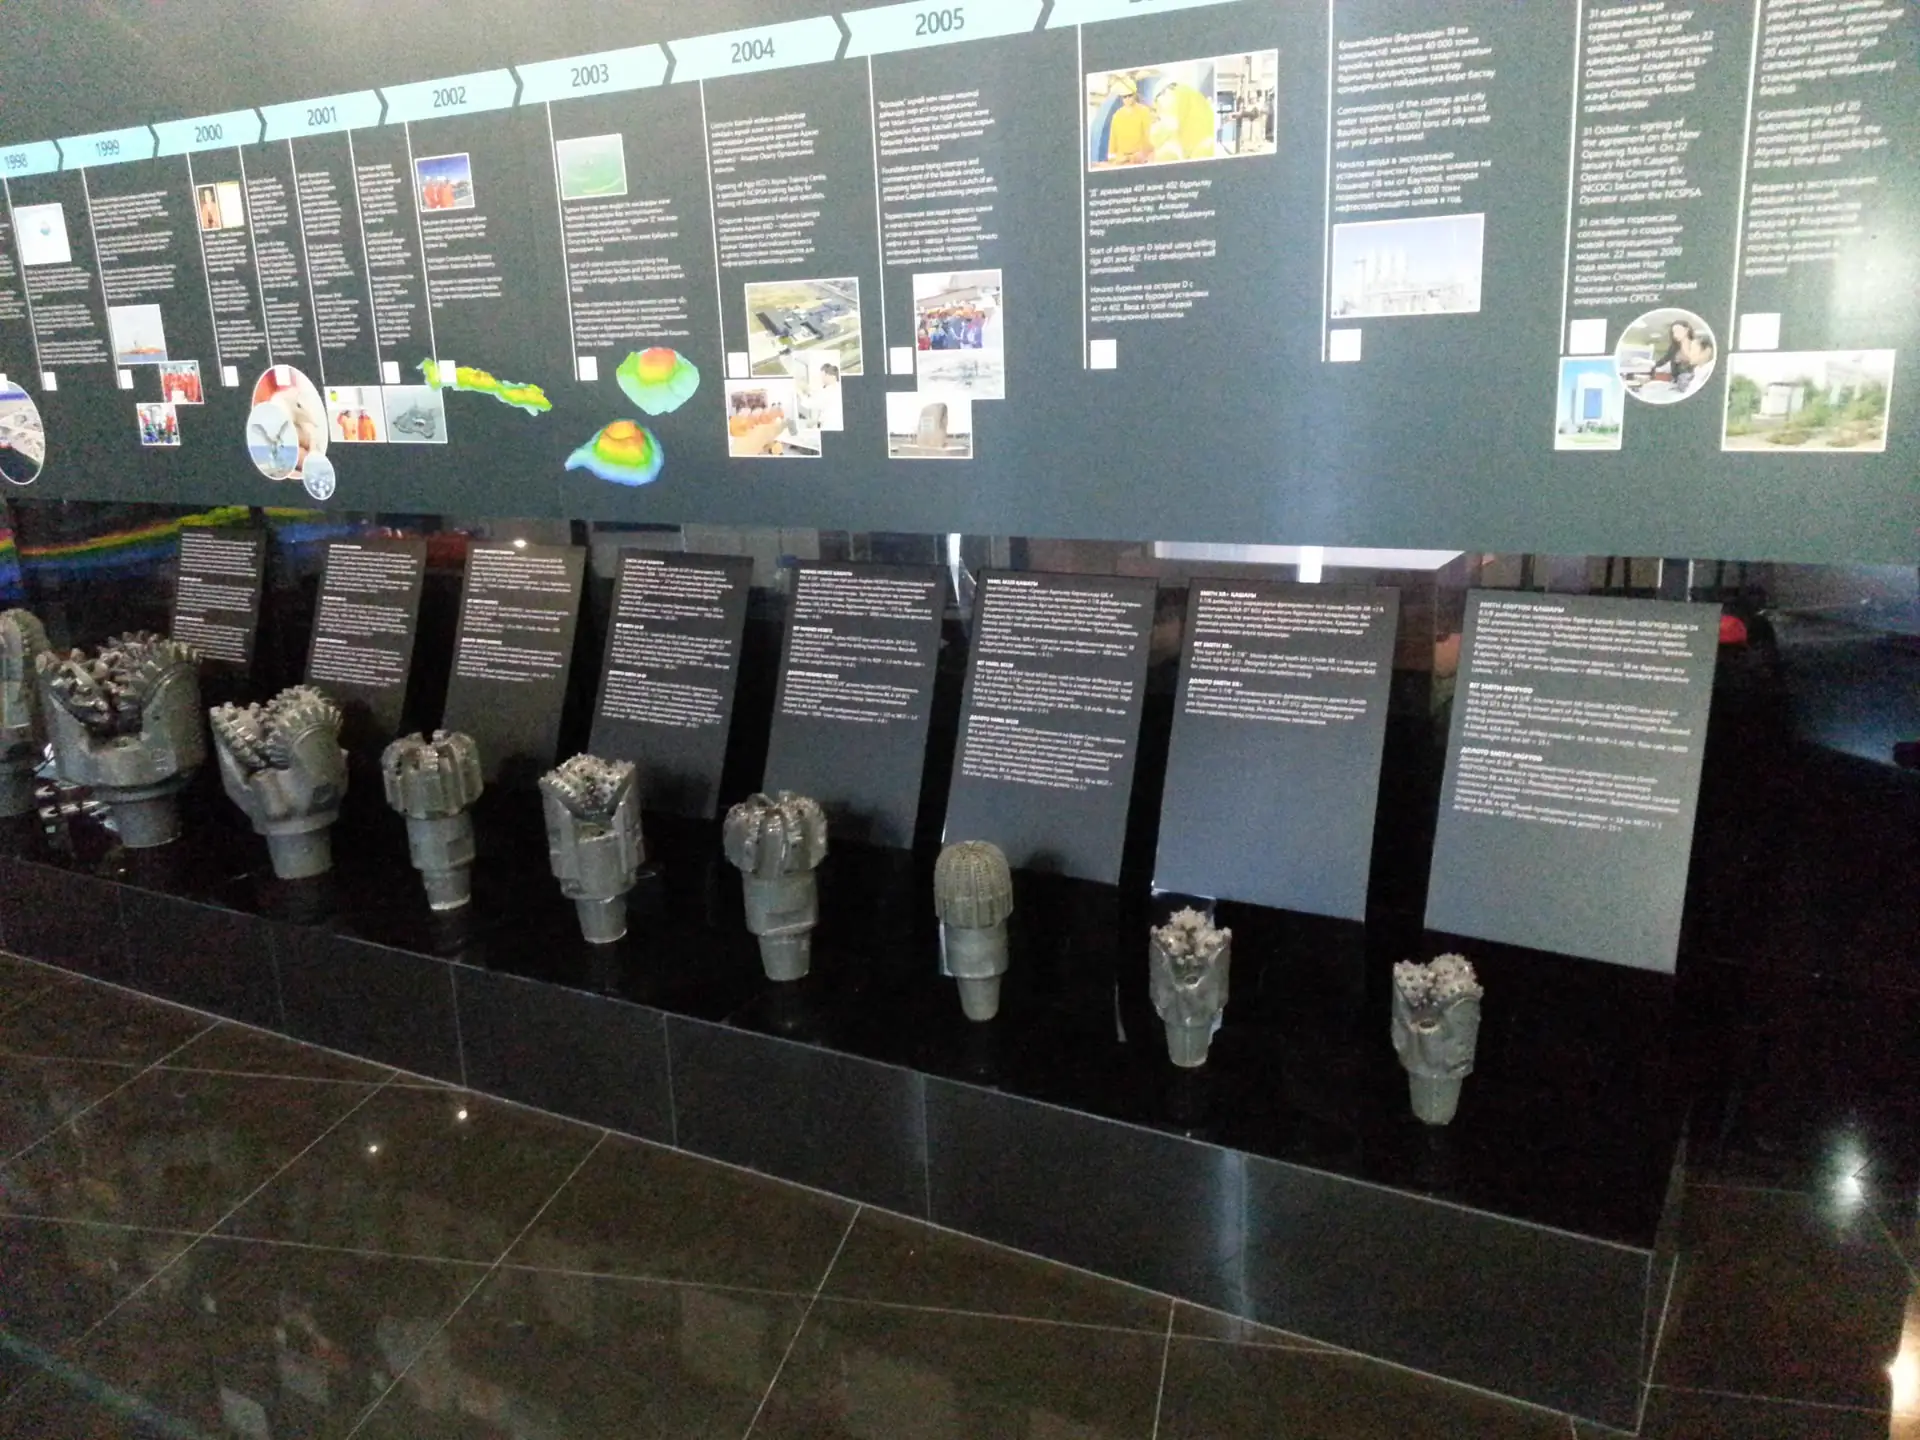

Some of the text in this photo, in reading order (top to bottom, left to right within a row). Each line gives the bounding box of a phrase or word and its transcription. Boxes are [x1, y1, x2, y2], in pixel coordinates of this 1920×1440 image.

[914, 7, 965, 36] 2005
[730, 38, 776, 64] 2004
[570, 64, 610, 87] 2003
[432, 86, 467, 108] 2002
[1337, 102, 1394, 115] Commissioning
[1396, 100, 1404, 109] of
[1406, 99, 1419, 108] the
[1420, 97, 1452, 106] cuttings
[1453, 94, 1469, 103] and
[306, 106, 338, 126] 2001
[1359, 112, 1396, 123] treatment
[1398, 110, 1423, 120] facility
[1479, 104, 1487, 112] of
[1369, 125, 1392, 133] where
[1442, 119, 1450, 127] of
[1468, 116, 1491, 125] waste
[1594, 125, 1630, 135] October
[1674, 119, 1684, 128] of
[194, 125, 222, 143] 2000
[1351, 138, 1368, 147] year
[1582, 138, 1596, 146] the
[1598, 134, 1645, 147] agreement
[1662, 132, 1678, 140] the
[94, 139, 121, 157] 1999
[1581, 143, 1687, 160] Operating On 22
[3, 152, 28, 170] 1998
[1615, 157, 1642, 167] North
[1644, 155, 1678, 166] Caspian
[1580, 169, 1668, 183] Operating Company
[1615, 179, 1687, 190] became the new
[1580, 191, 1662, 206] Operator under the
[1090, 247, 1104, 255] Start
[1106, 246, 1112, 254] of
[1114, 245, 1135, 254] drilling
[1175, 241, 1192, 250] using
[1194, 239, 1216, 248] drilling
[1613, 249, 1624, 258] 22
[1115, 255, 1127, 263] and
[1144, 253, 1157, 261] First
[1159, 250, 1200, 260] development
